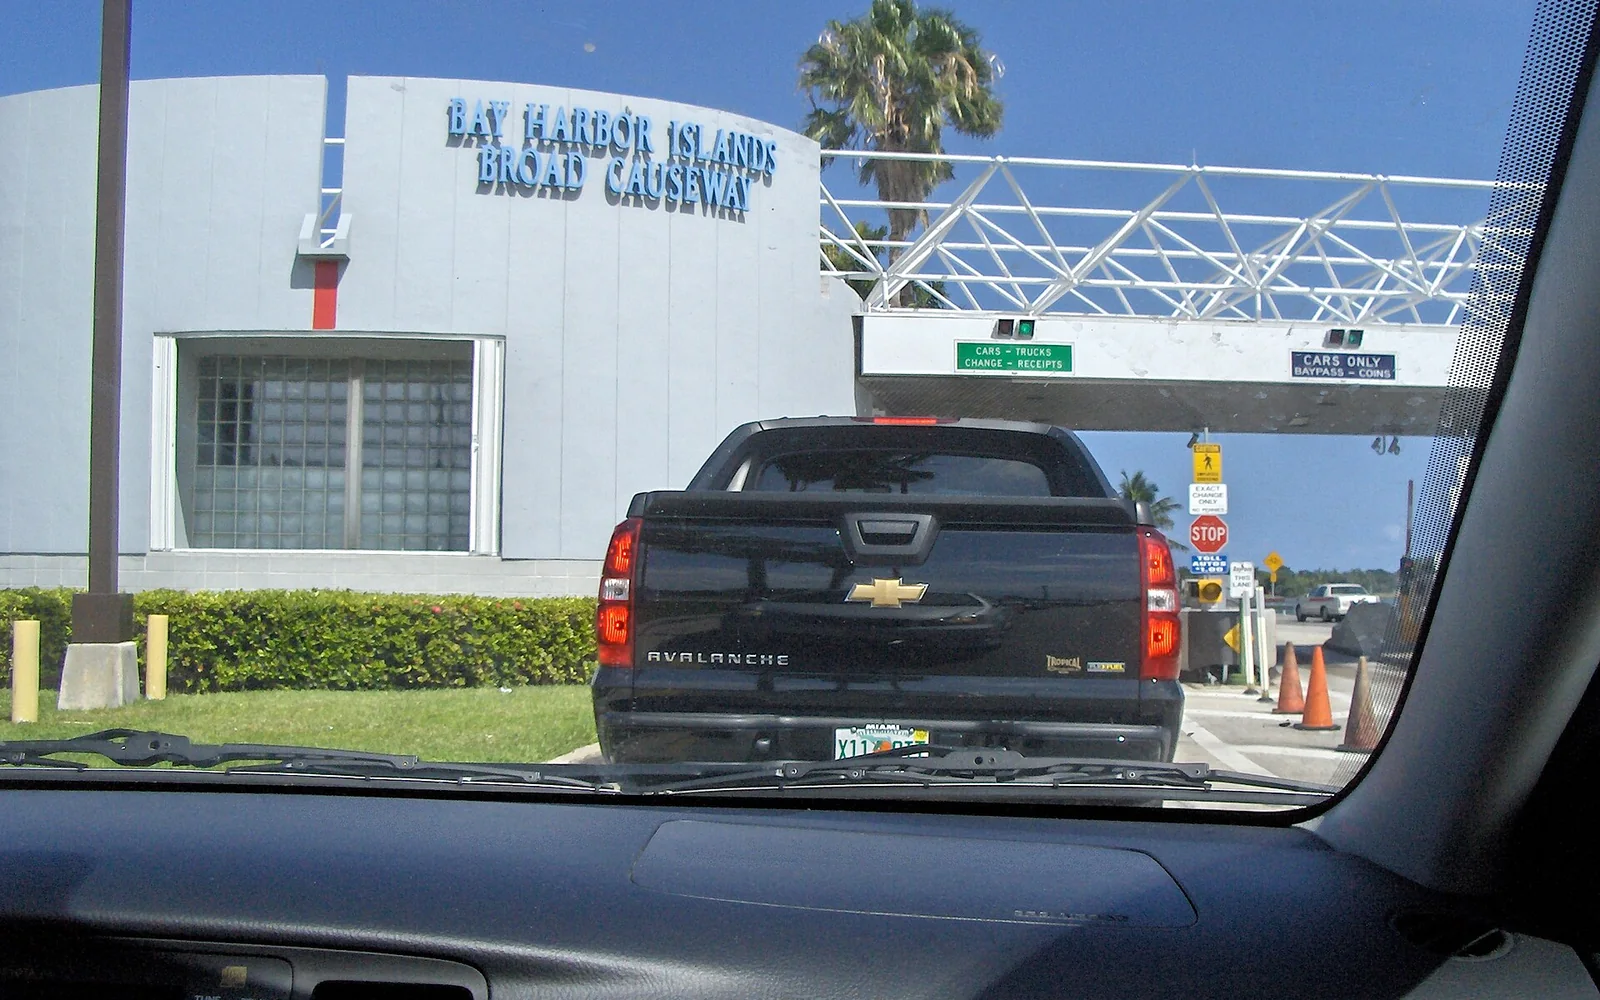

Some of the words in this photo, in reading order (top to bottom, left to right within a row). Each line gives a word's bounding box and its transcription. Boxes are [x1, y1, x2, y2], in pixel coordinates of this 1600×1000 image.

[449, 98, 510, 137] BAY
[525, 102, 654, 153] HARBOR
[668, 120, 777, 175] ISLANDS
[479, 144, 588, 189] BROAD
[606, 156, 754, 212] CAUSEWAY
[976, 347, 1001, 355] CARS
[1015, 347, 1052, 357] TRUCKS
[965, 358, 1003, 367] CHANGE
[1017, 359, 1063, 369] RECEIPTS
[1303, 354, 1340, 366] CARS
[1347, 355, 1381, 368] ONLY
[1294, 367, 1344, 377] BAYPASS
[1358, 368, 1391, 379] COINS
[1192, 526, 1226, 541] STOP
[647, 651, 789, 666] AVALANCHE
[1046, 654, 1081, 669] TROPICAL
